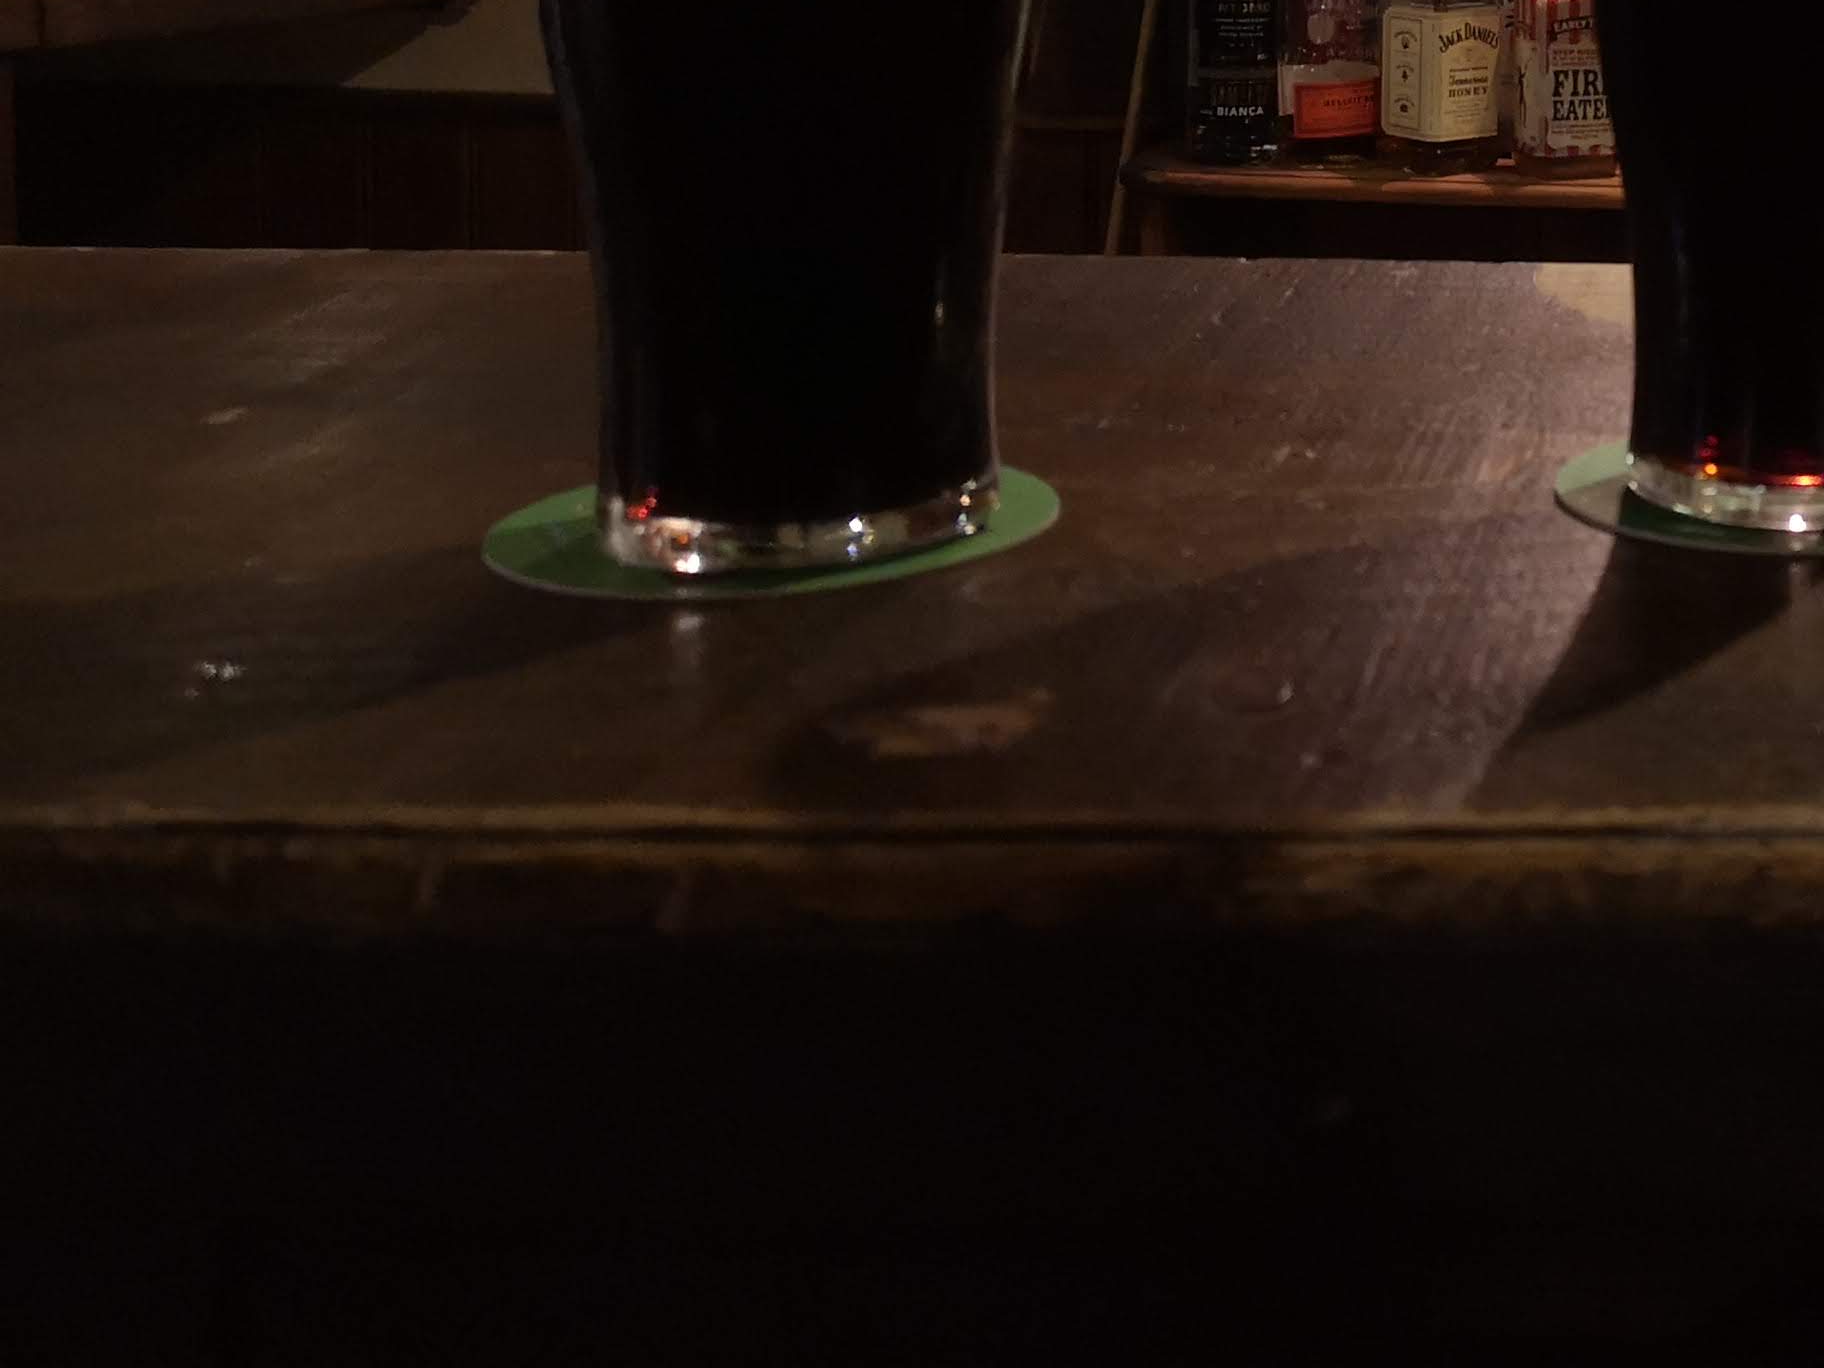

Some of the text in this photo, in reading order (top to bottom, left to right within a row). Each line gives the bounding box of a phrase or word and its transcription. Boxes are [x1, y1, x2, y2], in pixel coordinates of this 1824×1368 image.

[1438, 28, 1464, 54] JACK
[1448, 86, 1487, 99] HONEY
[1216, 105, 1265, 117] BIANCA
[1552, 99, 1609, 122] EATE
